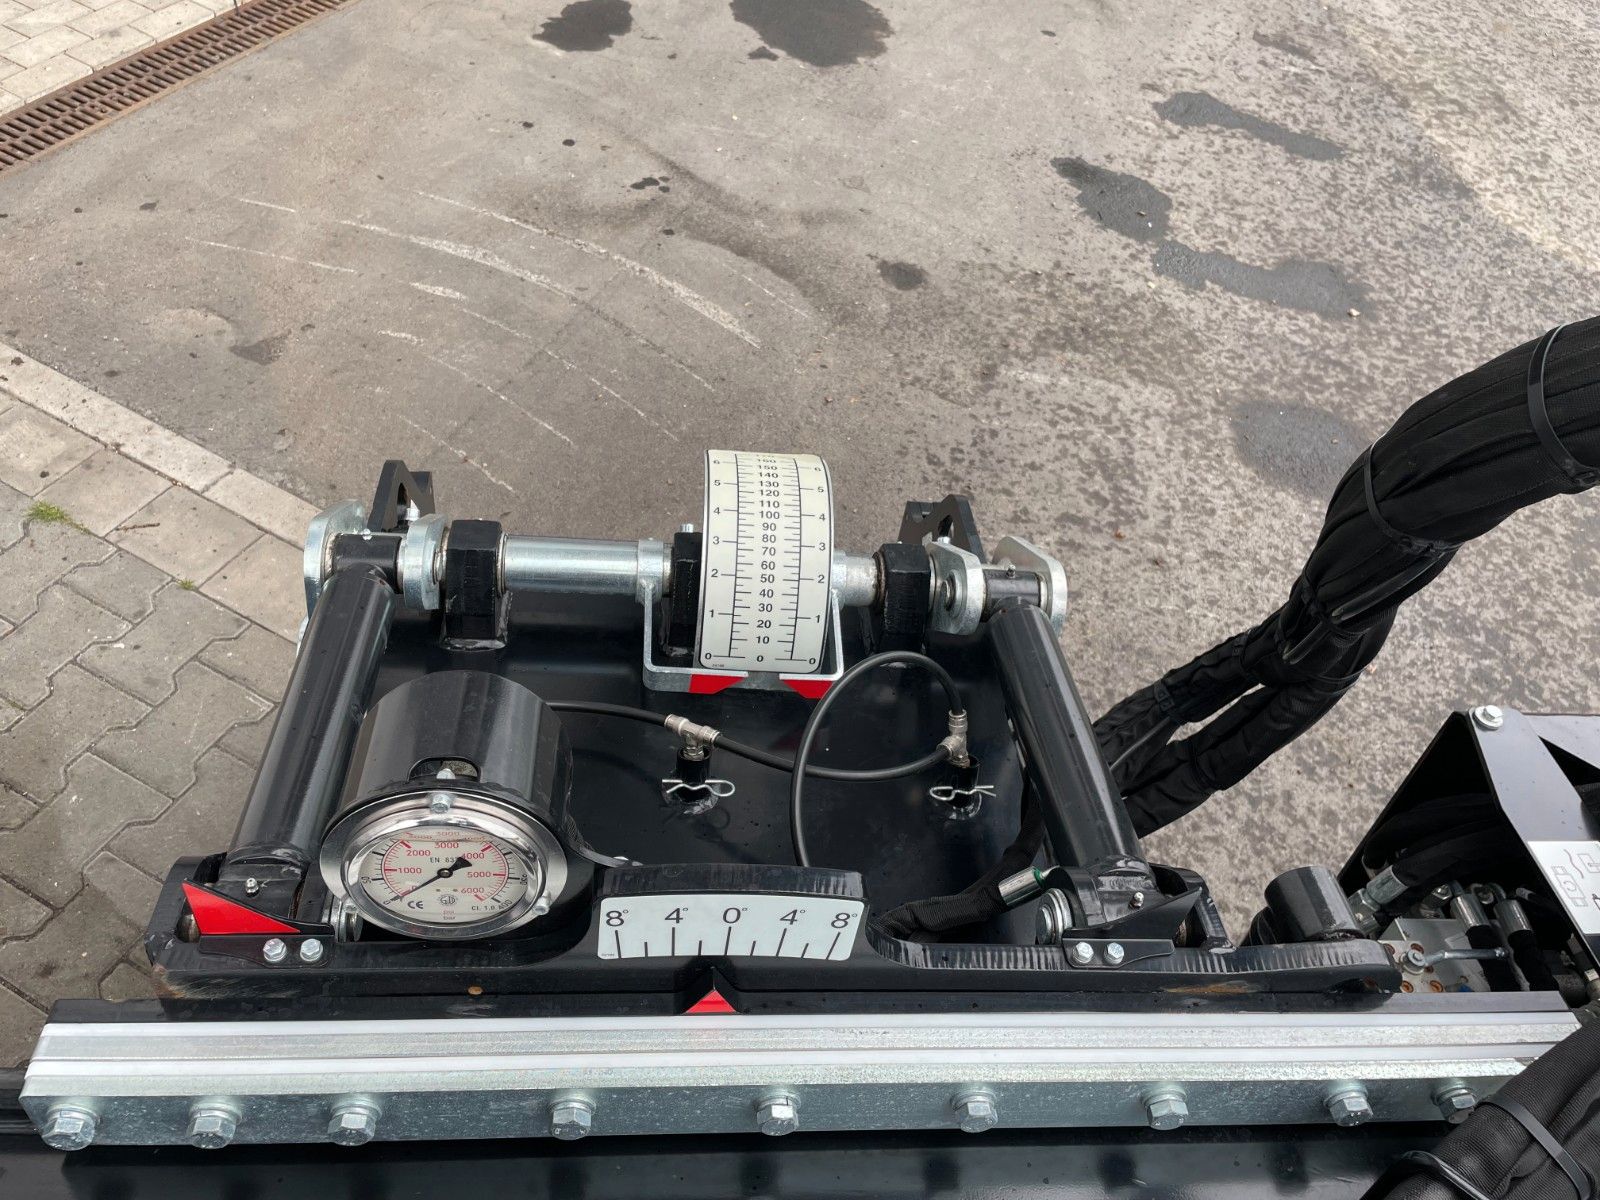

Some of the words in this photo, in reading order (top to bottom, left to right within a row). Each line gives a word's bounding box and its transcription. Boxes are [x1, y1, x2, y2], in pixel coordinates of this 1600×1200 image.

[760, 489, 780, 497] 120
[760, 500, 780, 508] 110
[714, 507, 721, 515] 4
[760, 511, 780, 519] 100
[819, 513, 826, 521] 4
[762, 523, 777, 531] 90
[712, 536, 720, 545] 3
[762, 534, 777, 543] 80
[818, 542, 826, 551] 3
[762, 547, 776, 556] 70
[761, 561, 776, 570] 60
[711, 568, 719, 578] 2
[760, 574, 775, 583] 50
[818, 574, 825, 584] 2
[759, 588, 774, 598] 40
[758, 602, 773, 612] 30
[709, 609, 715, 618] 1
[815, 615, 821, 623] 1
[756, 620, 772, 628] 20
[756, 636, 770, 644] 10
[705, 652, 712, 660] 0
[808, 657, 816, 665] 0
